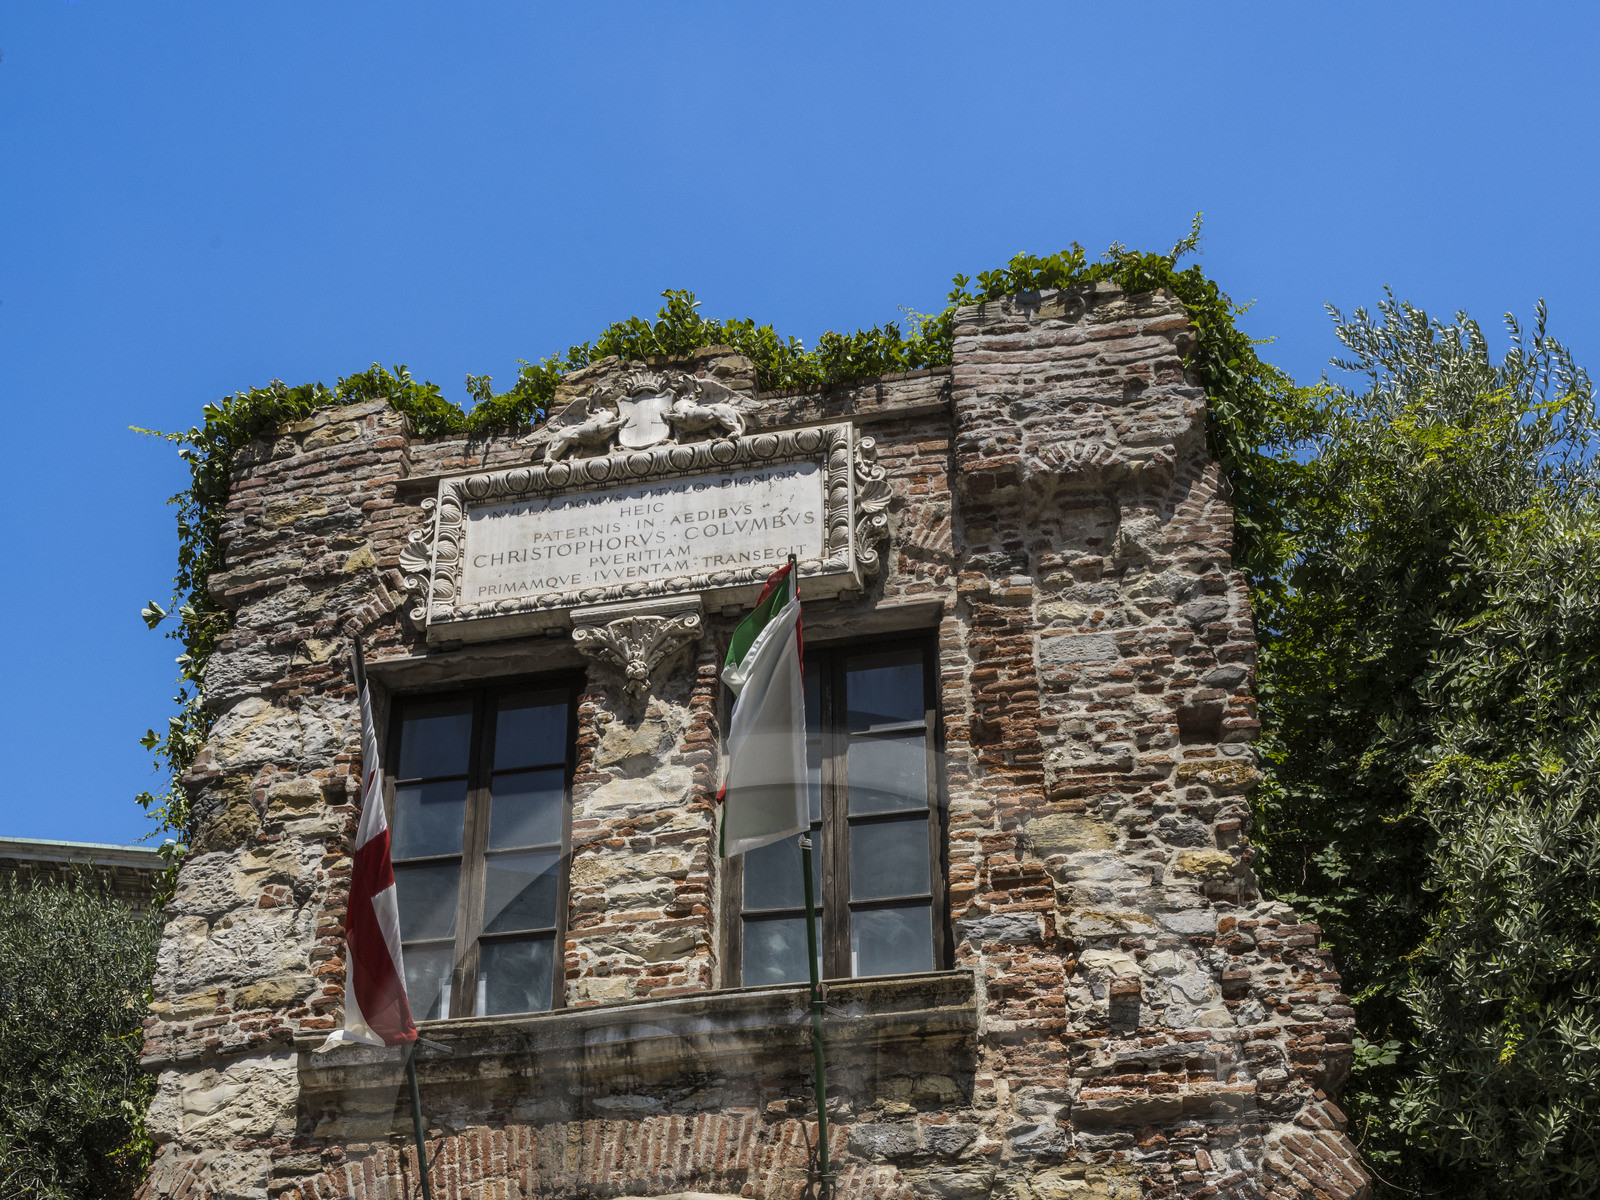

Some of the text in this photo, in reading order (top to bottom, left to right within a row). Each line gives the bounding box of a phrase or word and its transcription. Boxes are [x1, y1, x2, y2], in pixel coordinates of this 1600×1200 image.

[533, 504, 753, 543] PATERNIS IN AEDIBVS
[620, 502, 664, 518] HEIC
[473, 511, 815, 568] CHRISTOPHORVS COLVMBVS
[589, 545, 691, 567] PVERITIAM
[478, 573, 582, 597] PRIMAMQVE
[594, 559, 689, 582] IVVENTAM
